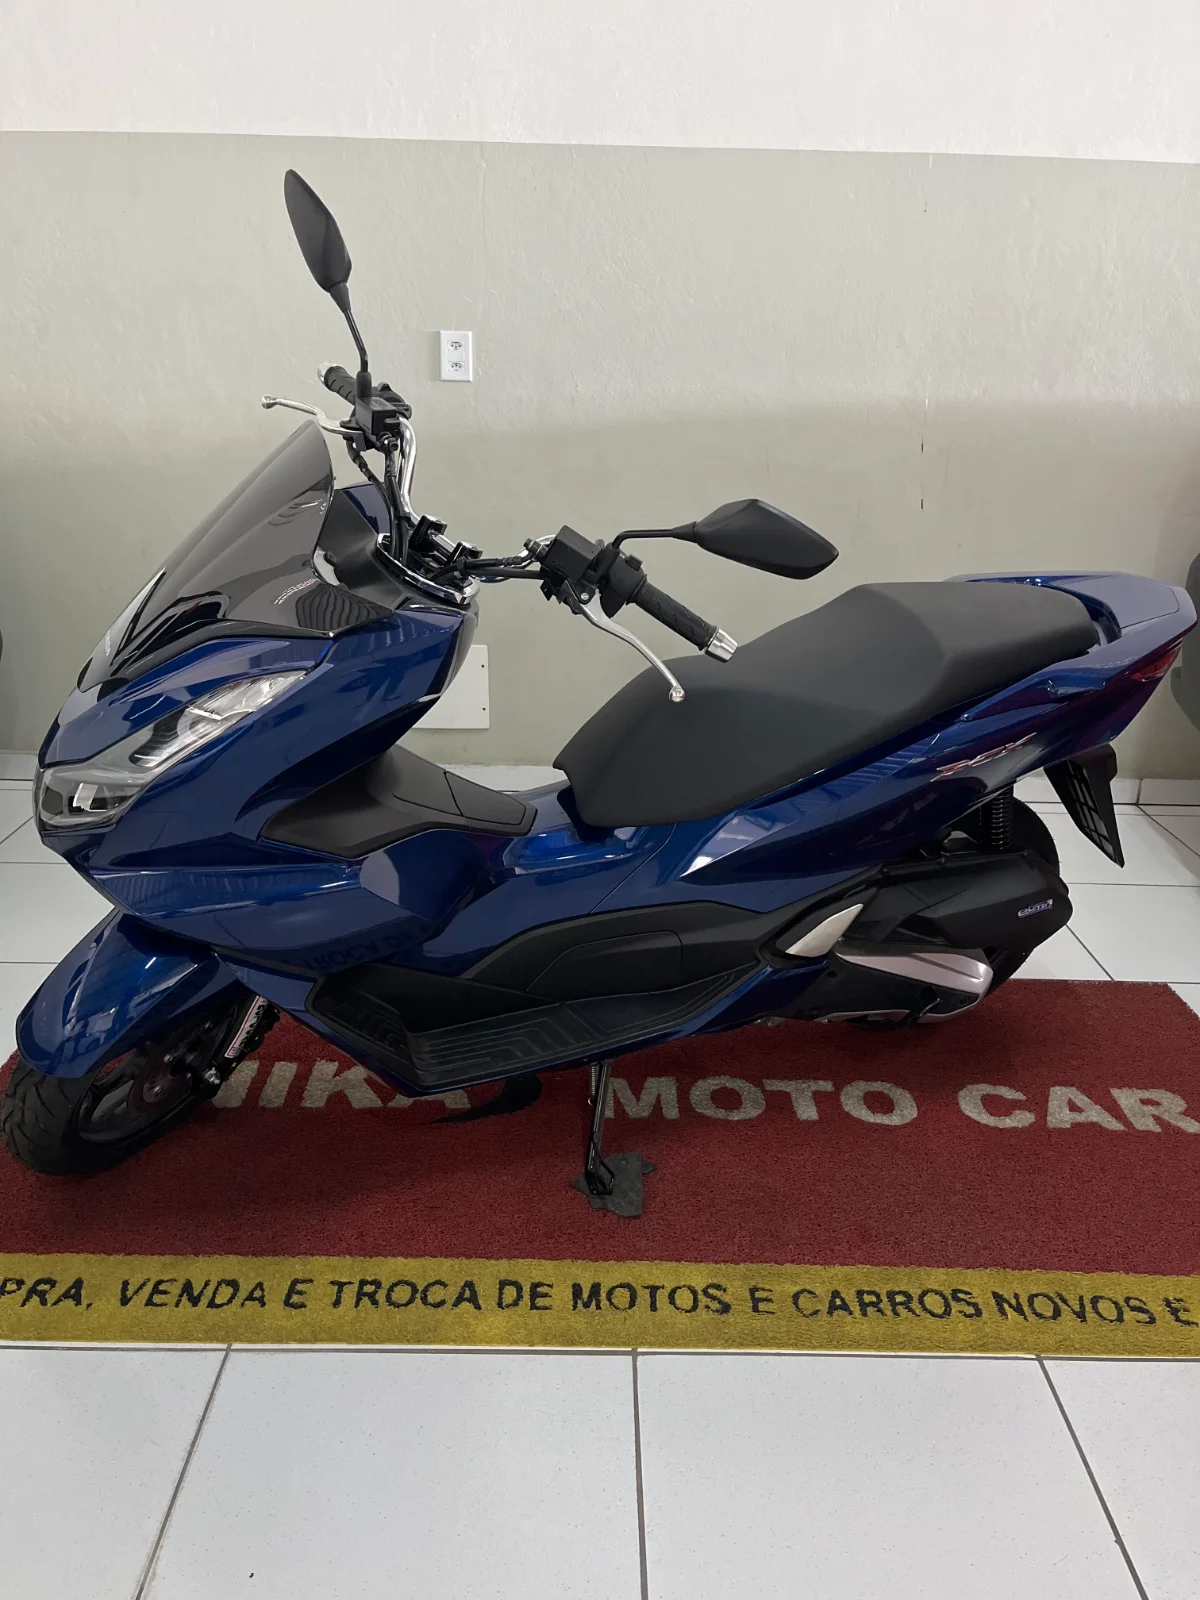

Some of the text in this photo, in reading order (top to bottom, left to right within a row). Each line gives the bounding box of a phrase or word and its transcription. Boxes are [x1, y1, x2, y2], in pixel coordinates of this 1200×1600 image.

[604, 1075, 918, 1126] MOTO
[957, 1083, 1200, 1133] CAR
[119, 1277, 267, 1309] VENDA
[283, 1277, 314, 1310] E
[329, 1278, 482, 1311] TROCA
[497, 1279, 554, 1311] DE
[571, 1282, 732, 1315] MOTOS
[749, 1285, 776, 1315] E
[792, 1288, 984, 1319] CARROS
[991, 1290, 1157, 1325] NOVOS
[1163, 1296, 1200, 1328] E
